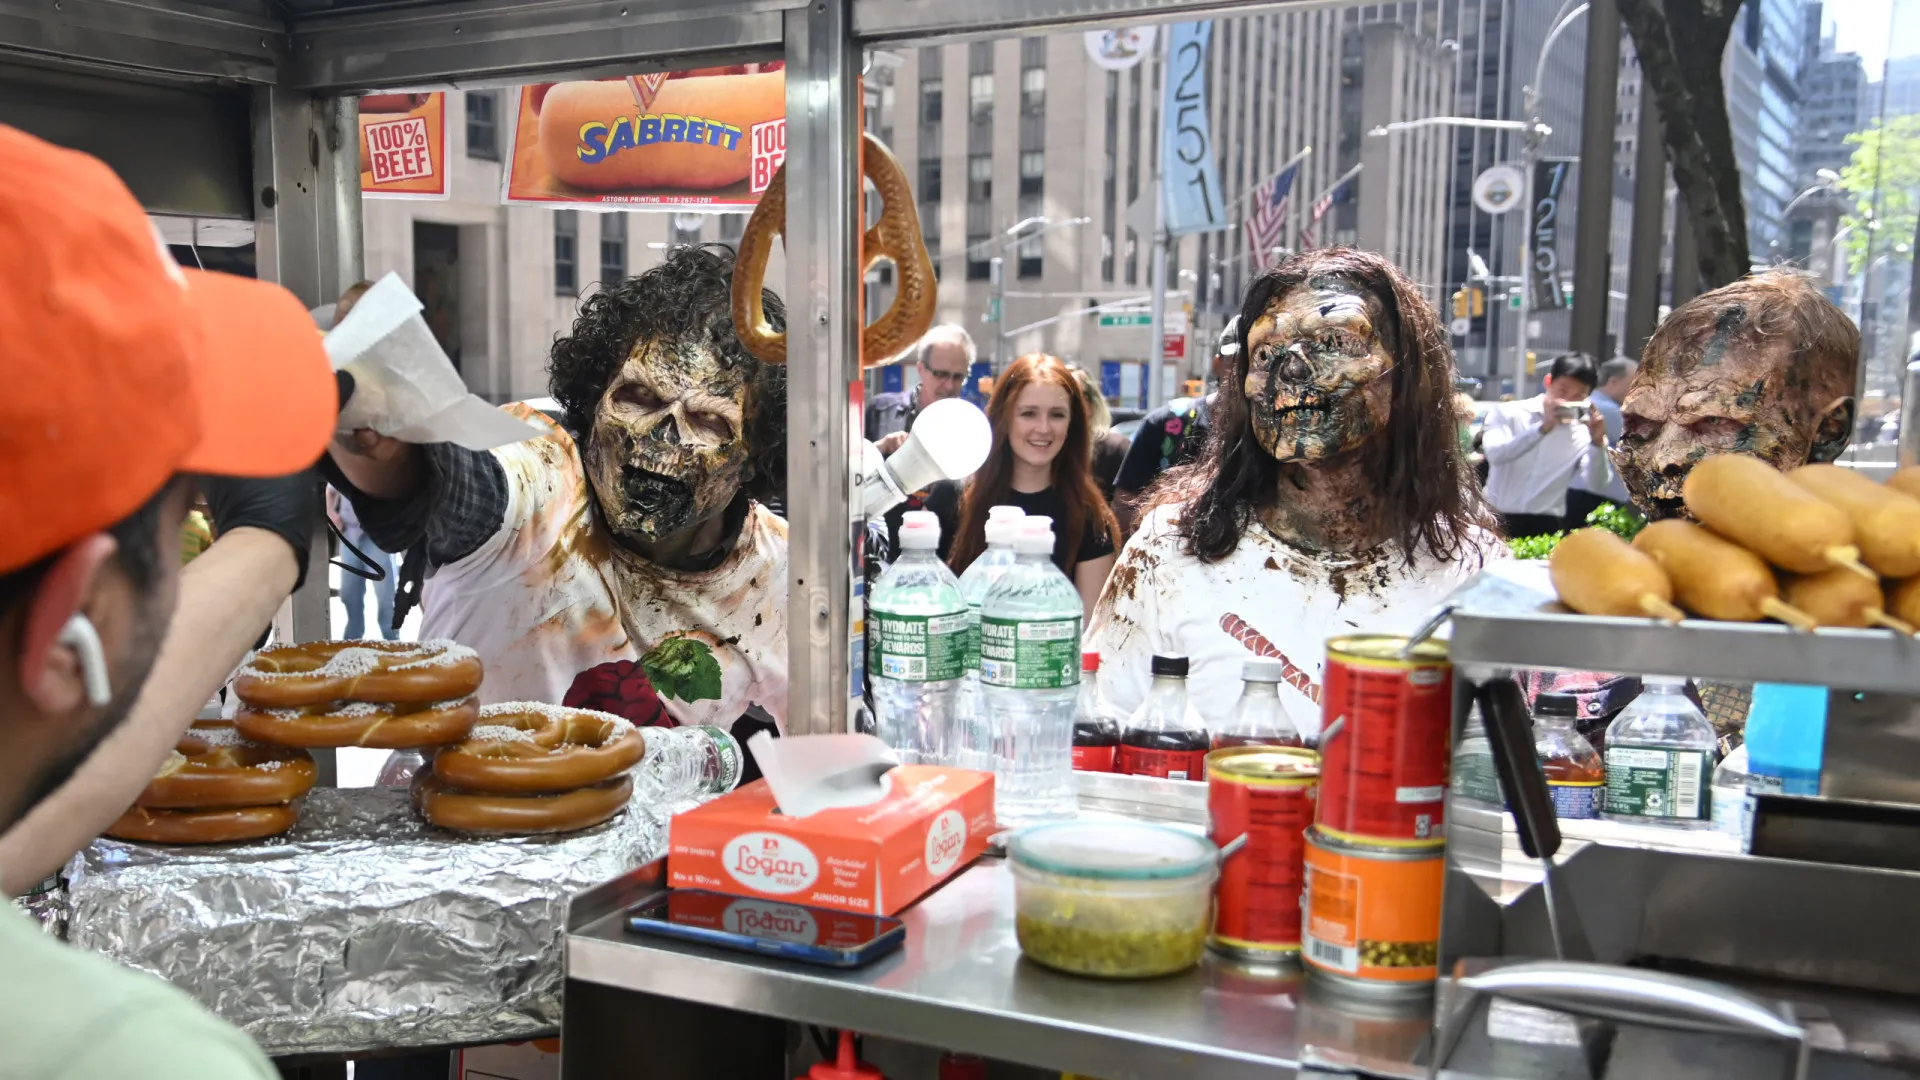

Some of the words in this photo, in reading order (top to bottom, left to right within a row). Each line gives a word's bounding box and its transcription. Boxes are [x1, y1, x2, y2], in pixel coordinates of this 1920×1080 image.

[370, 121, 424, 151] 100%
[577, 113, 742, 164] SABRETT
[755, 122, 787, 155] 100
[374, 147, 426, 179] BEEF
[755, 153, 782, 188] BE
[630, 196, 660, 204] PRINTING
[1536, 162, 1563, 307] 1251
[882, 619, 926, 635] HYDRATE
[882, 640, 926, 655] REWARDS!
[735, 844, 808, 877] Logan
[931, 832, 962, 864] Logan
[811, 891, 846, 904] JUNIOR
[848, 897, 869, 909] SIZE
